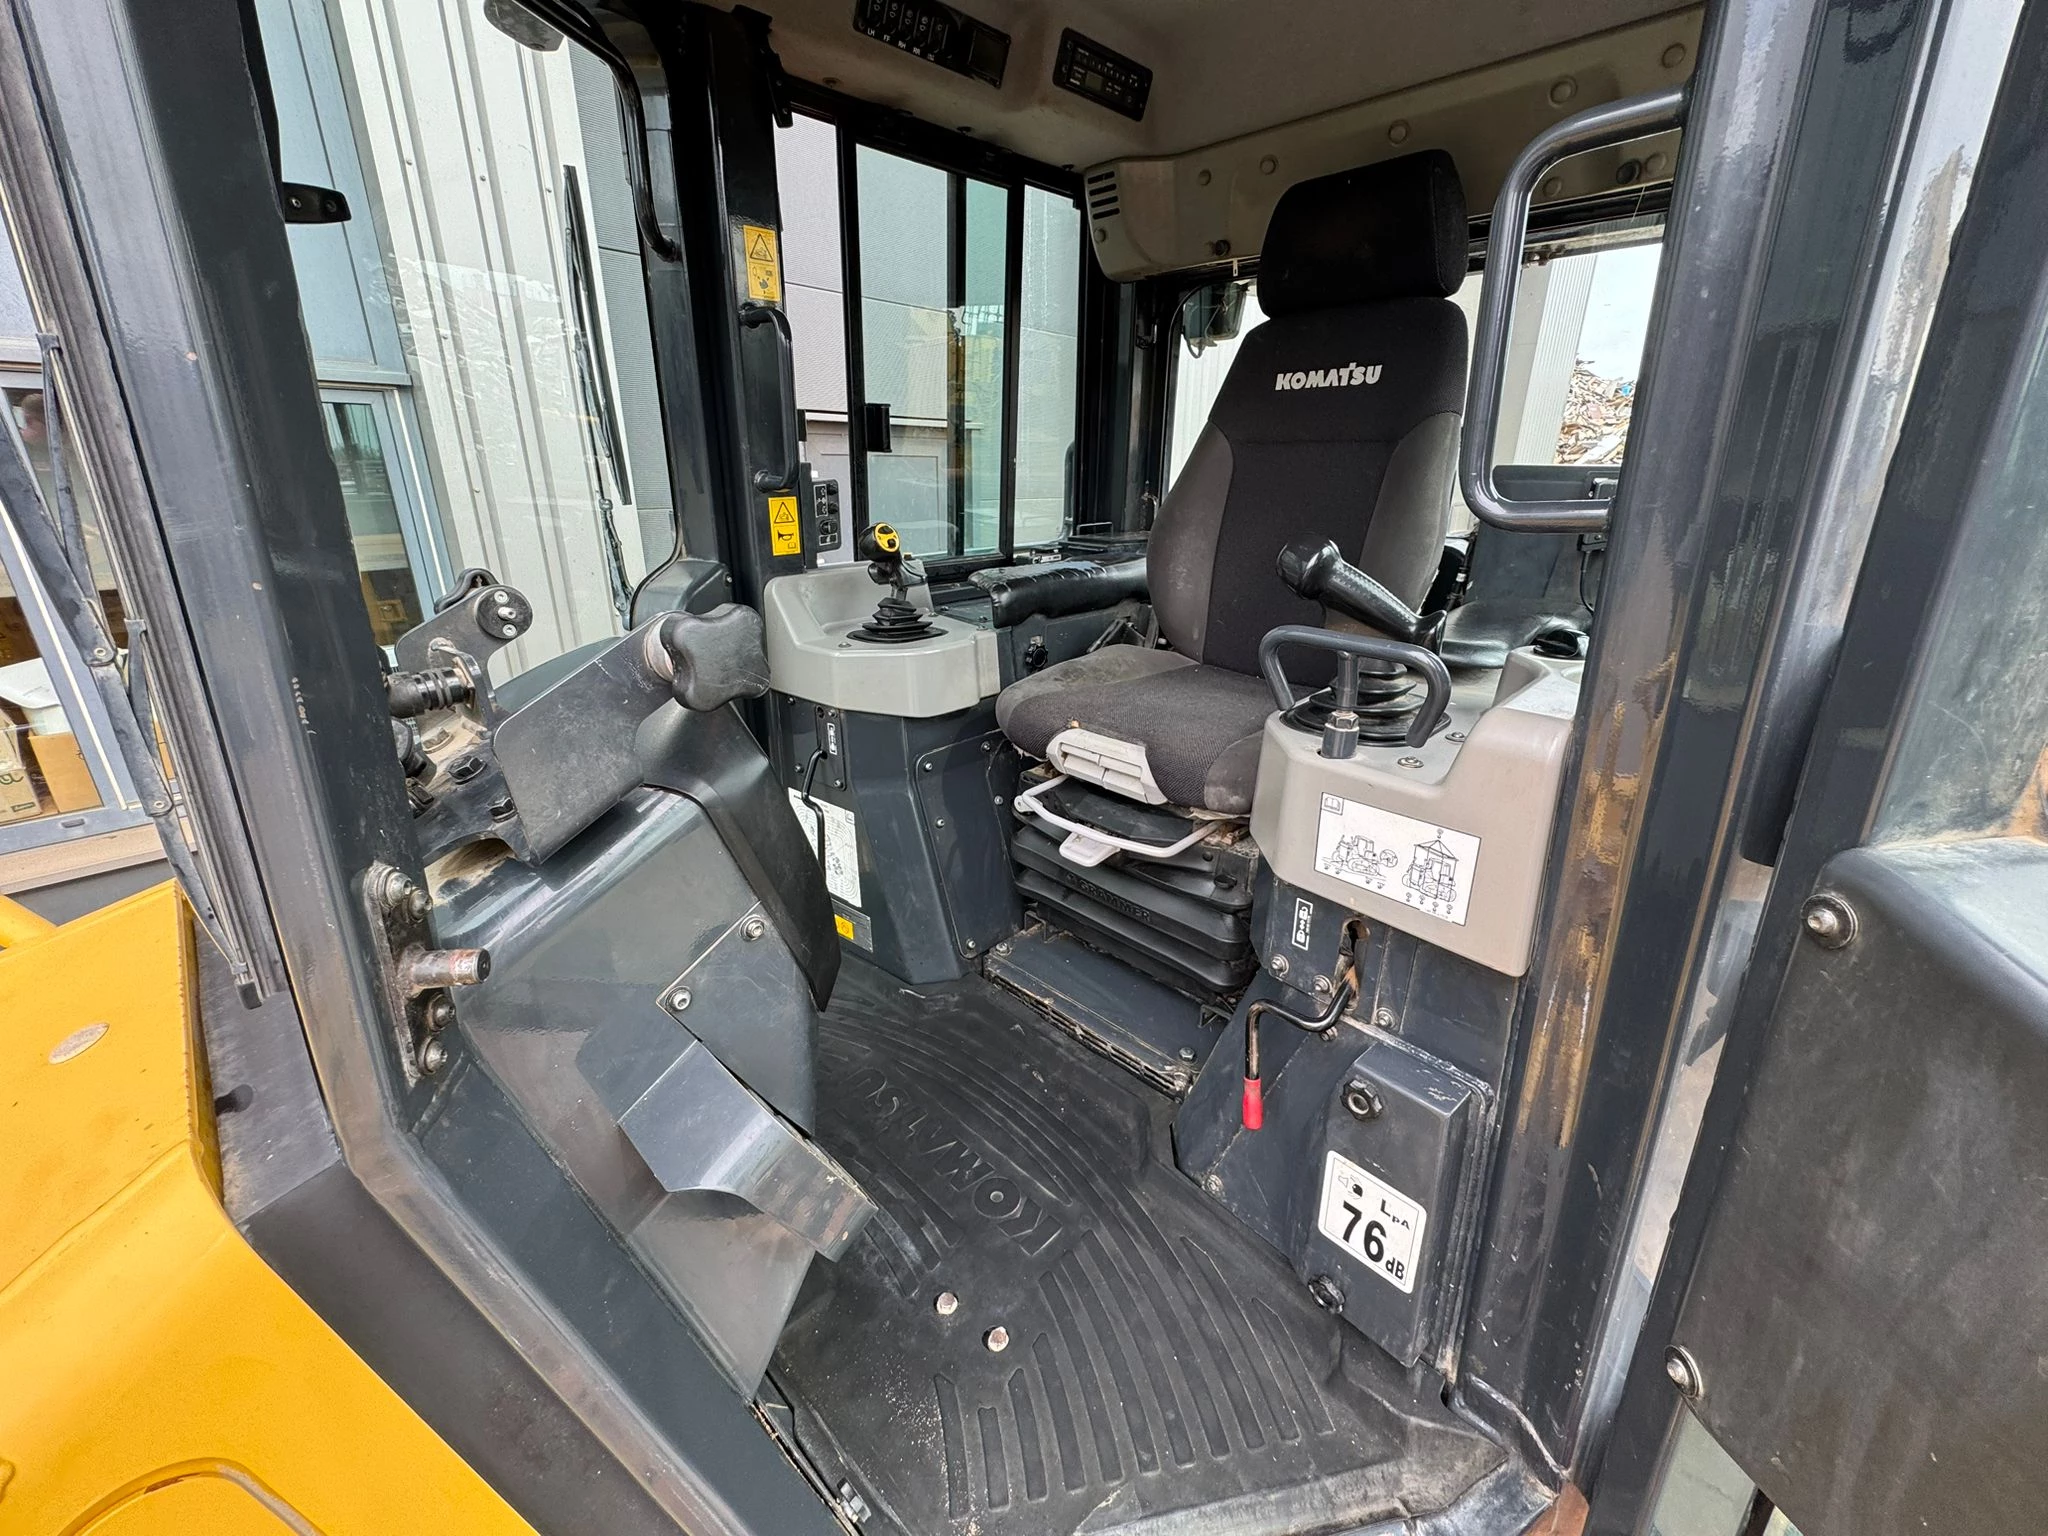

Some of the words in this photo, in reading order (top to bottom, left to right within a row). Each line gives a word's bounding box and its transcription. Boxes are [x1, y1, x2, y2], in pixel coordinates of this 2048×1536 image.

[1275, 362, 1383, 391] KOMATSU
[1380, 1198, 1410, 1231] LpA
[1342, 1200, 1387, 1263] 76
[1385, 1257, 1405, 1281] dB
